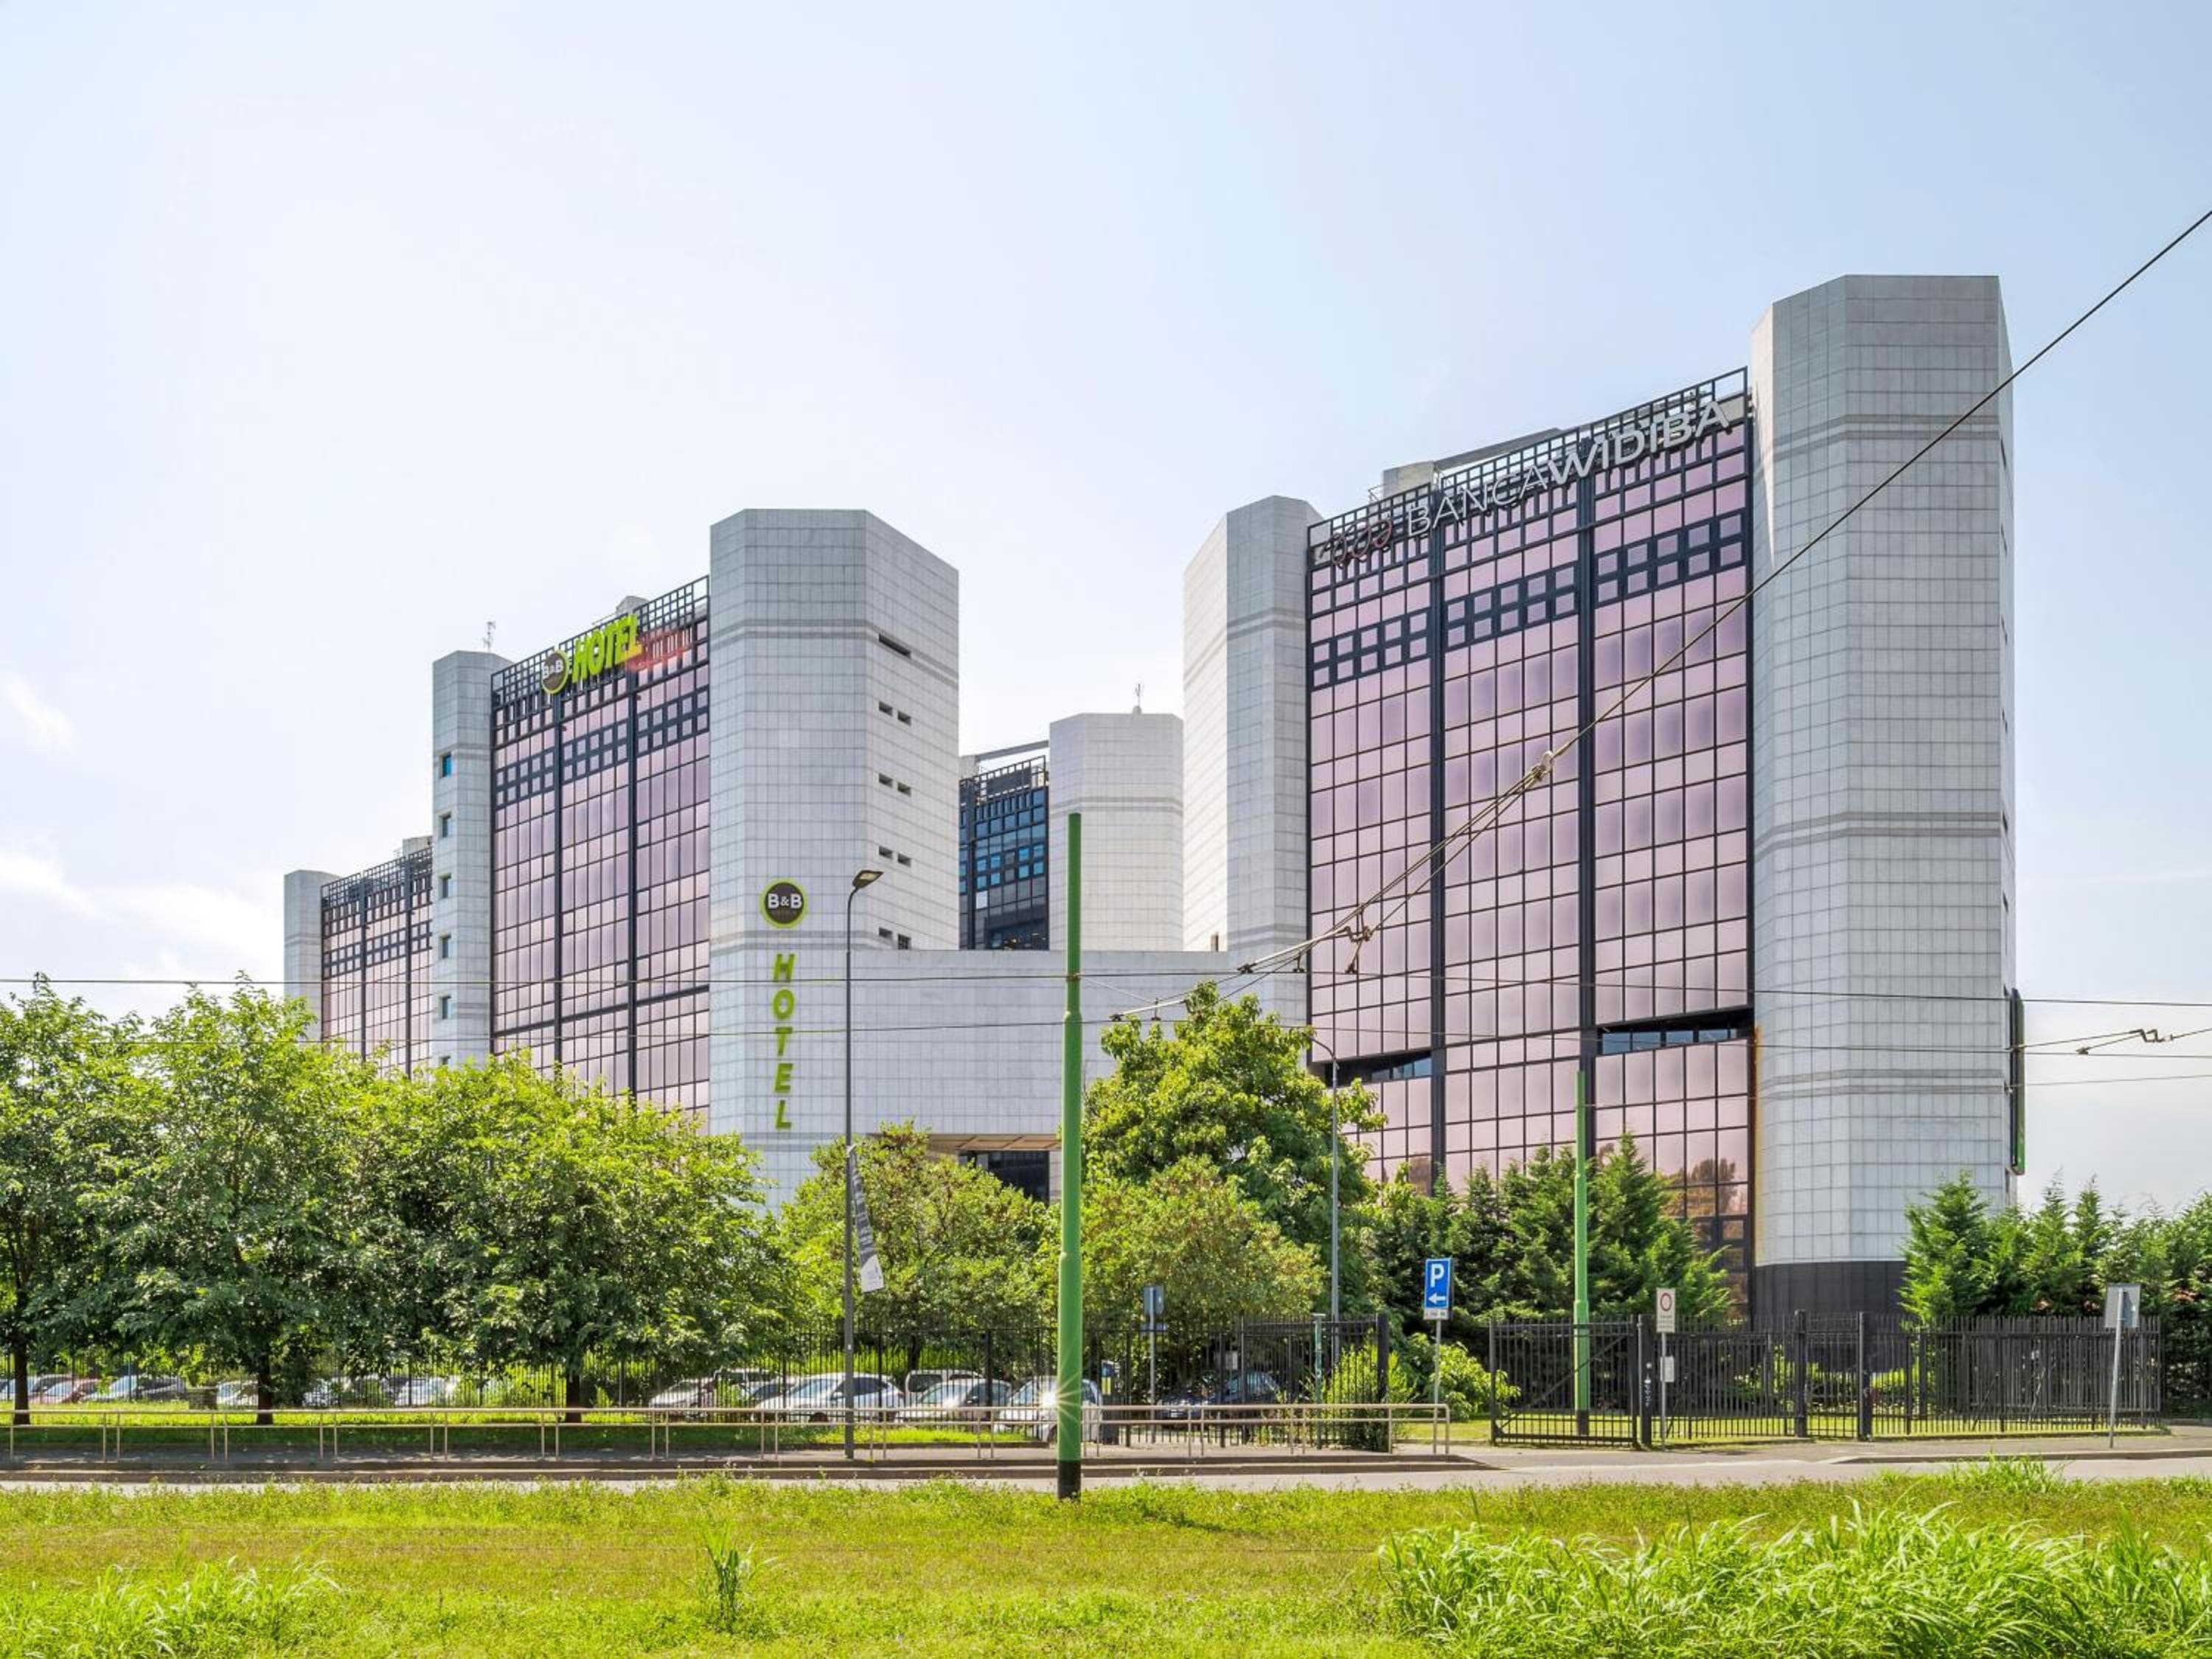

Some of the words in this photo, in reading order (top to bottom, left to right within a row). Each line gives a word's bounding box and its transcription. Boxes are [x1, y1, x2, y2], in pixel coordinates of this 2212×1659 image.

[572, 613, 642, 684] HOTEL
[768, 893, 802, 909] B&B
[773, 953, 795, 1130] HOTEL
[1430, 1263, 1445, 1288] P
